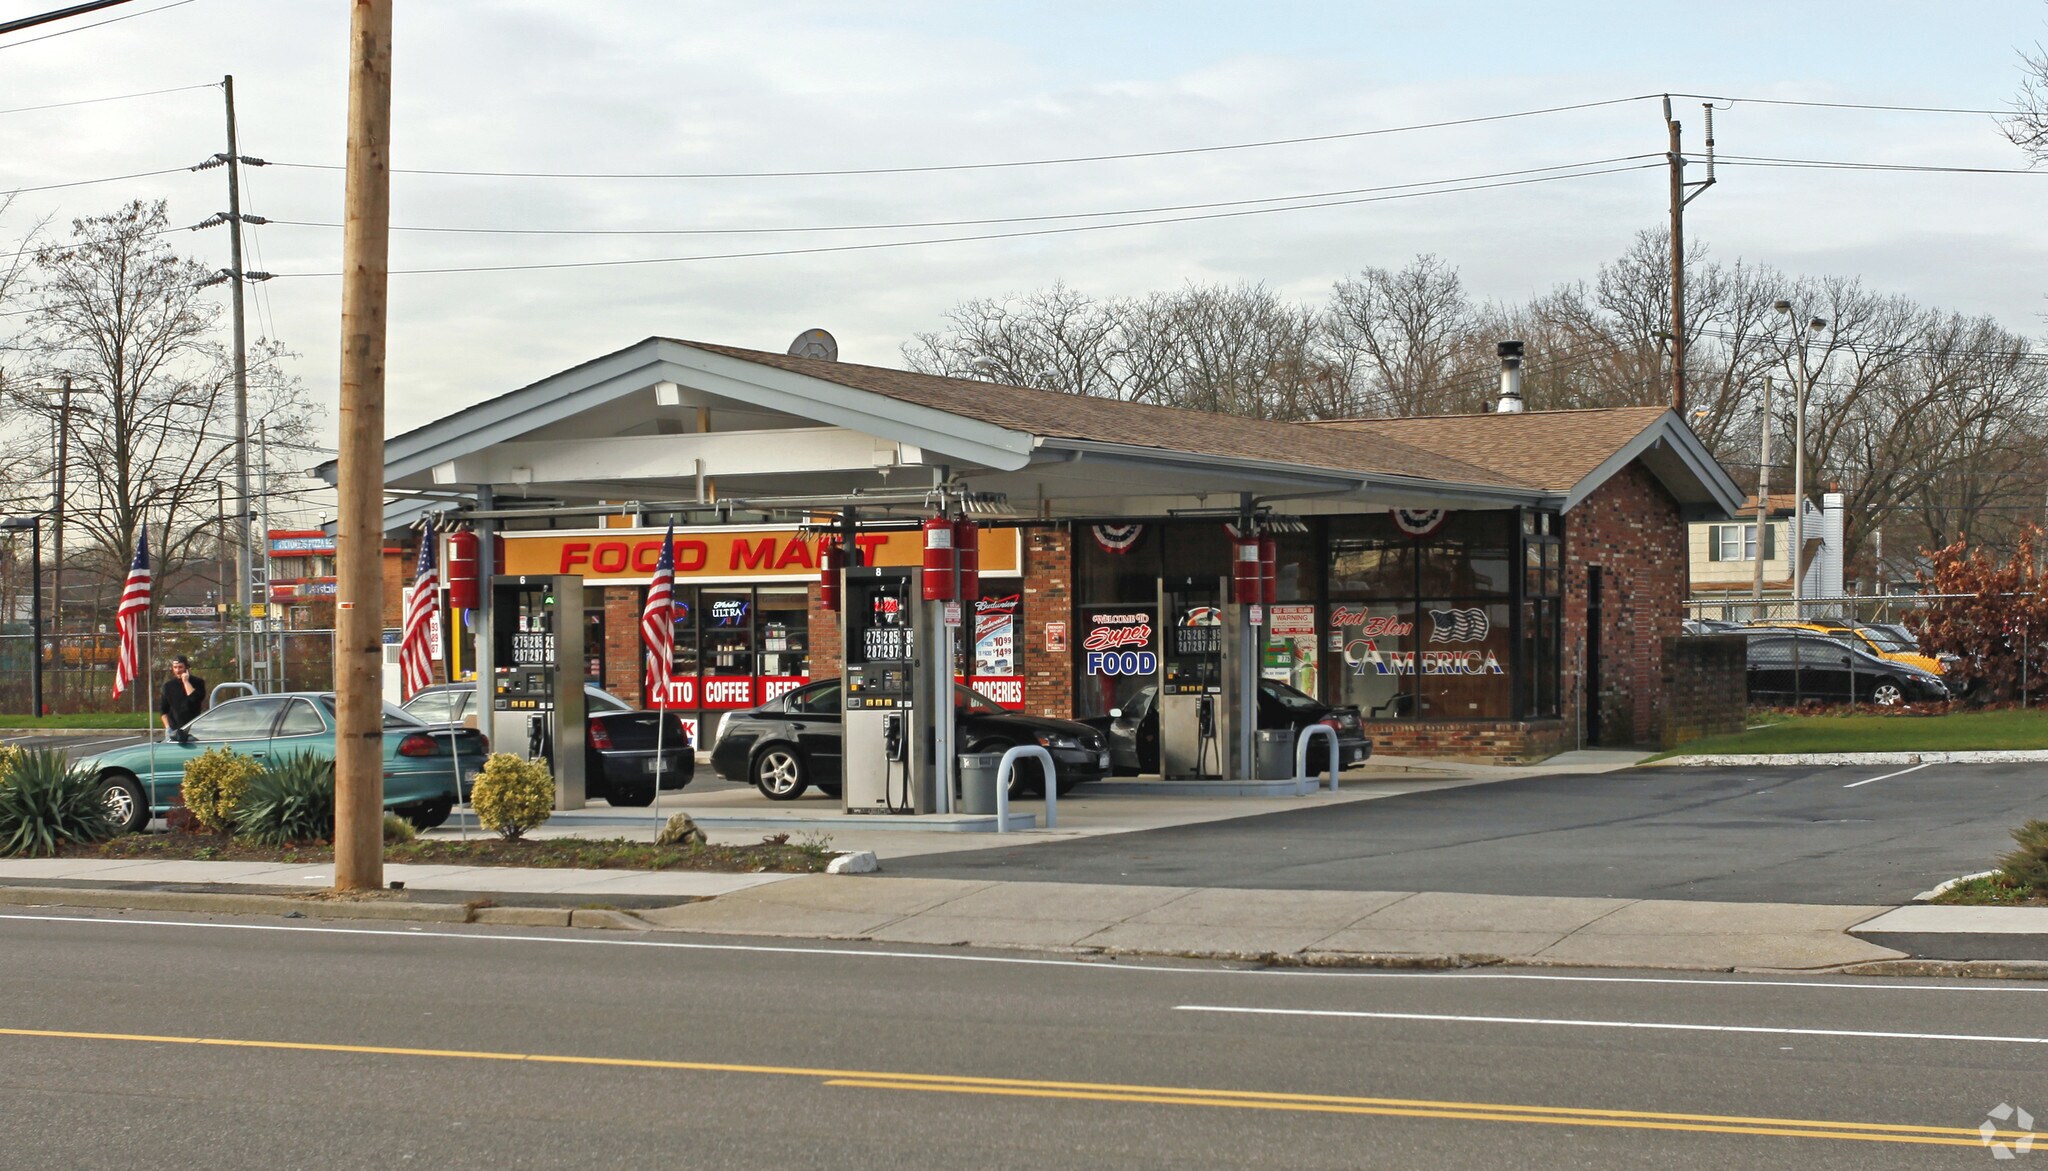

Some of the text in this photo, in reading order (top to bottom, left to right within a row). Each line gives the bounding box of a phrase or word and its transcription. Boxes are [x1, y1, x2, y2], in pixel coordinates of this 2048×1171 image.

[559, 539, 708, 574] FOOD
[729, 535, 889, 571] MAT
[875, 567, 882, 576] 8
[520, 575, 526, 584] 6
[712, 608, 743, 618] ULTRA
[1092, 613, 1150, 624] WELCOME TO
[1330, 606, 1414, 637] God Bless
[866, 631, 881, 644] 275
[883, 631, 898, 644] 285
[1083, 624, 1152, 652] Super
[867, 645, 881, 658] 287
[884, 645, 898, 658] 297
[1344, 638, 1504, 676] AMERICA
[1087, 651, 1157, 676] FOOD
[705, 681, 749, 703] COFFEE
[682, 721, 695, 736] K
